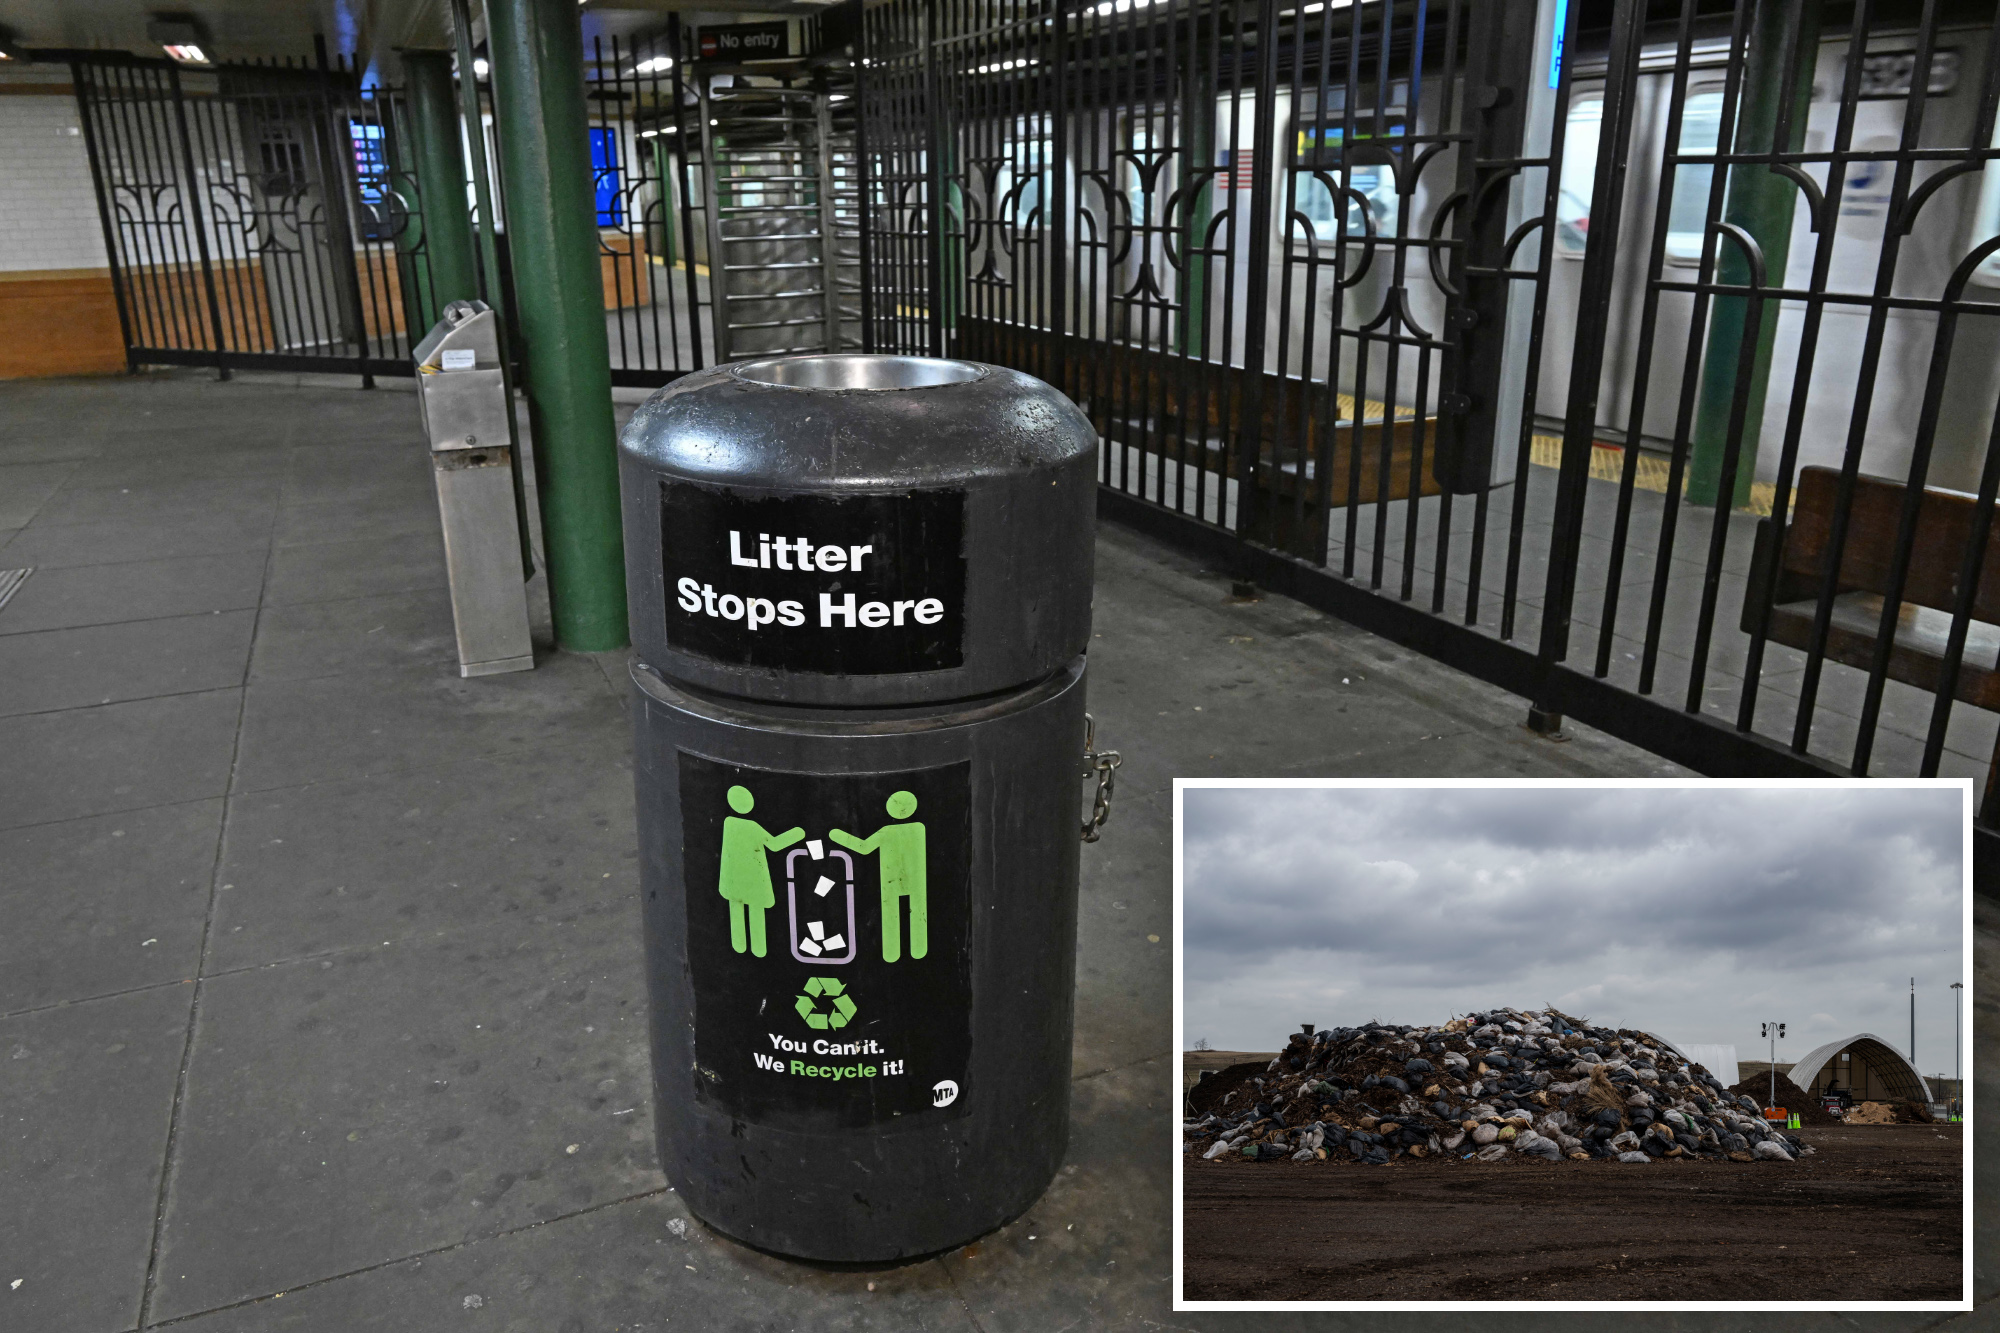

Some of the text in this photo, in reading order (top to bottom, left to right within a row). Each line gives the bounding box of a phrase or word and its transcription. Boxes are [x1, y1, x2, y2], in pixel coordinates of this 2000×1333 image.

[720, 32, 779, 48] No entry
[729, 530, 873, 572] Litter
[677, 577, 944, 631] Stops Here
[768, 1033, 807, 1053] You
[813, 1039, 859, 1055] Can
[753, 1052, 904, 1081] We Recycle it!
[932, 1086, 955, 1103] MTA
